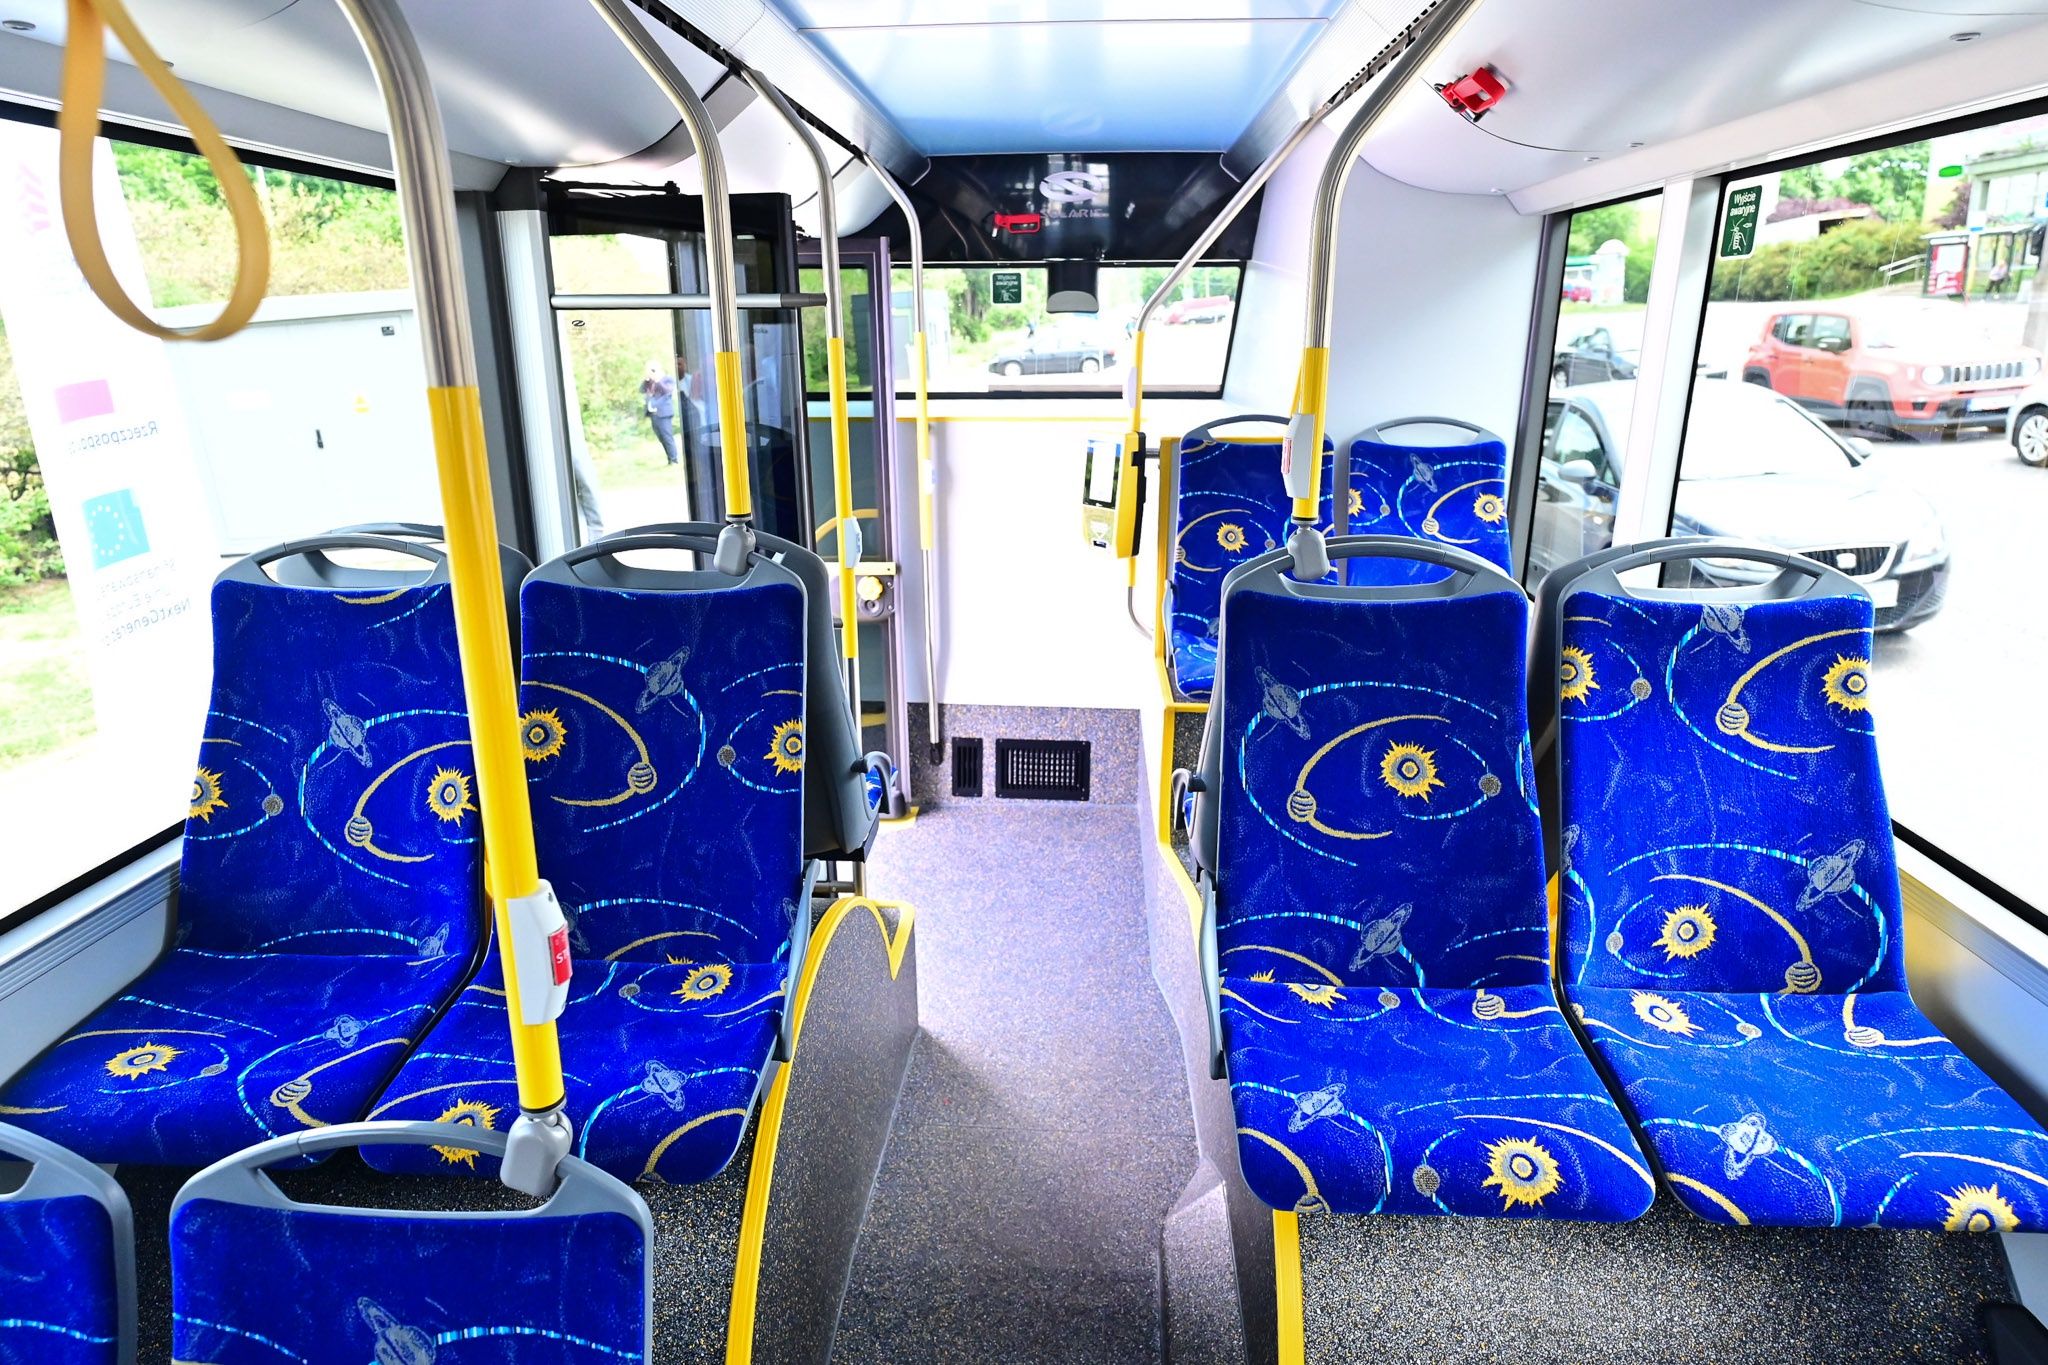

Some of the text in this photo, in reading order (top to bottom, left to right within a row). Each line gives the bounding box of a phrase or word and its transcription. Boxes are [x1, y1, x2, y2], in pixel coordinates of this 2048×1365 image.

[1734, 191, 1757, 206] Wyjście
[1729, 203, 1756, 217] awaryjne
[555, 948, 570, 965] ST
